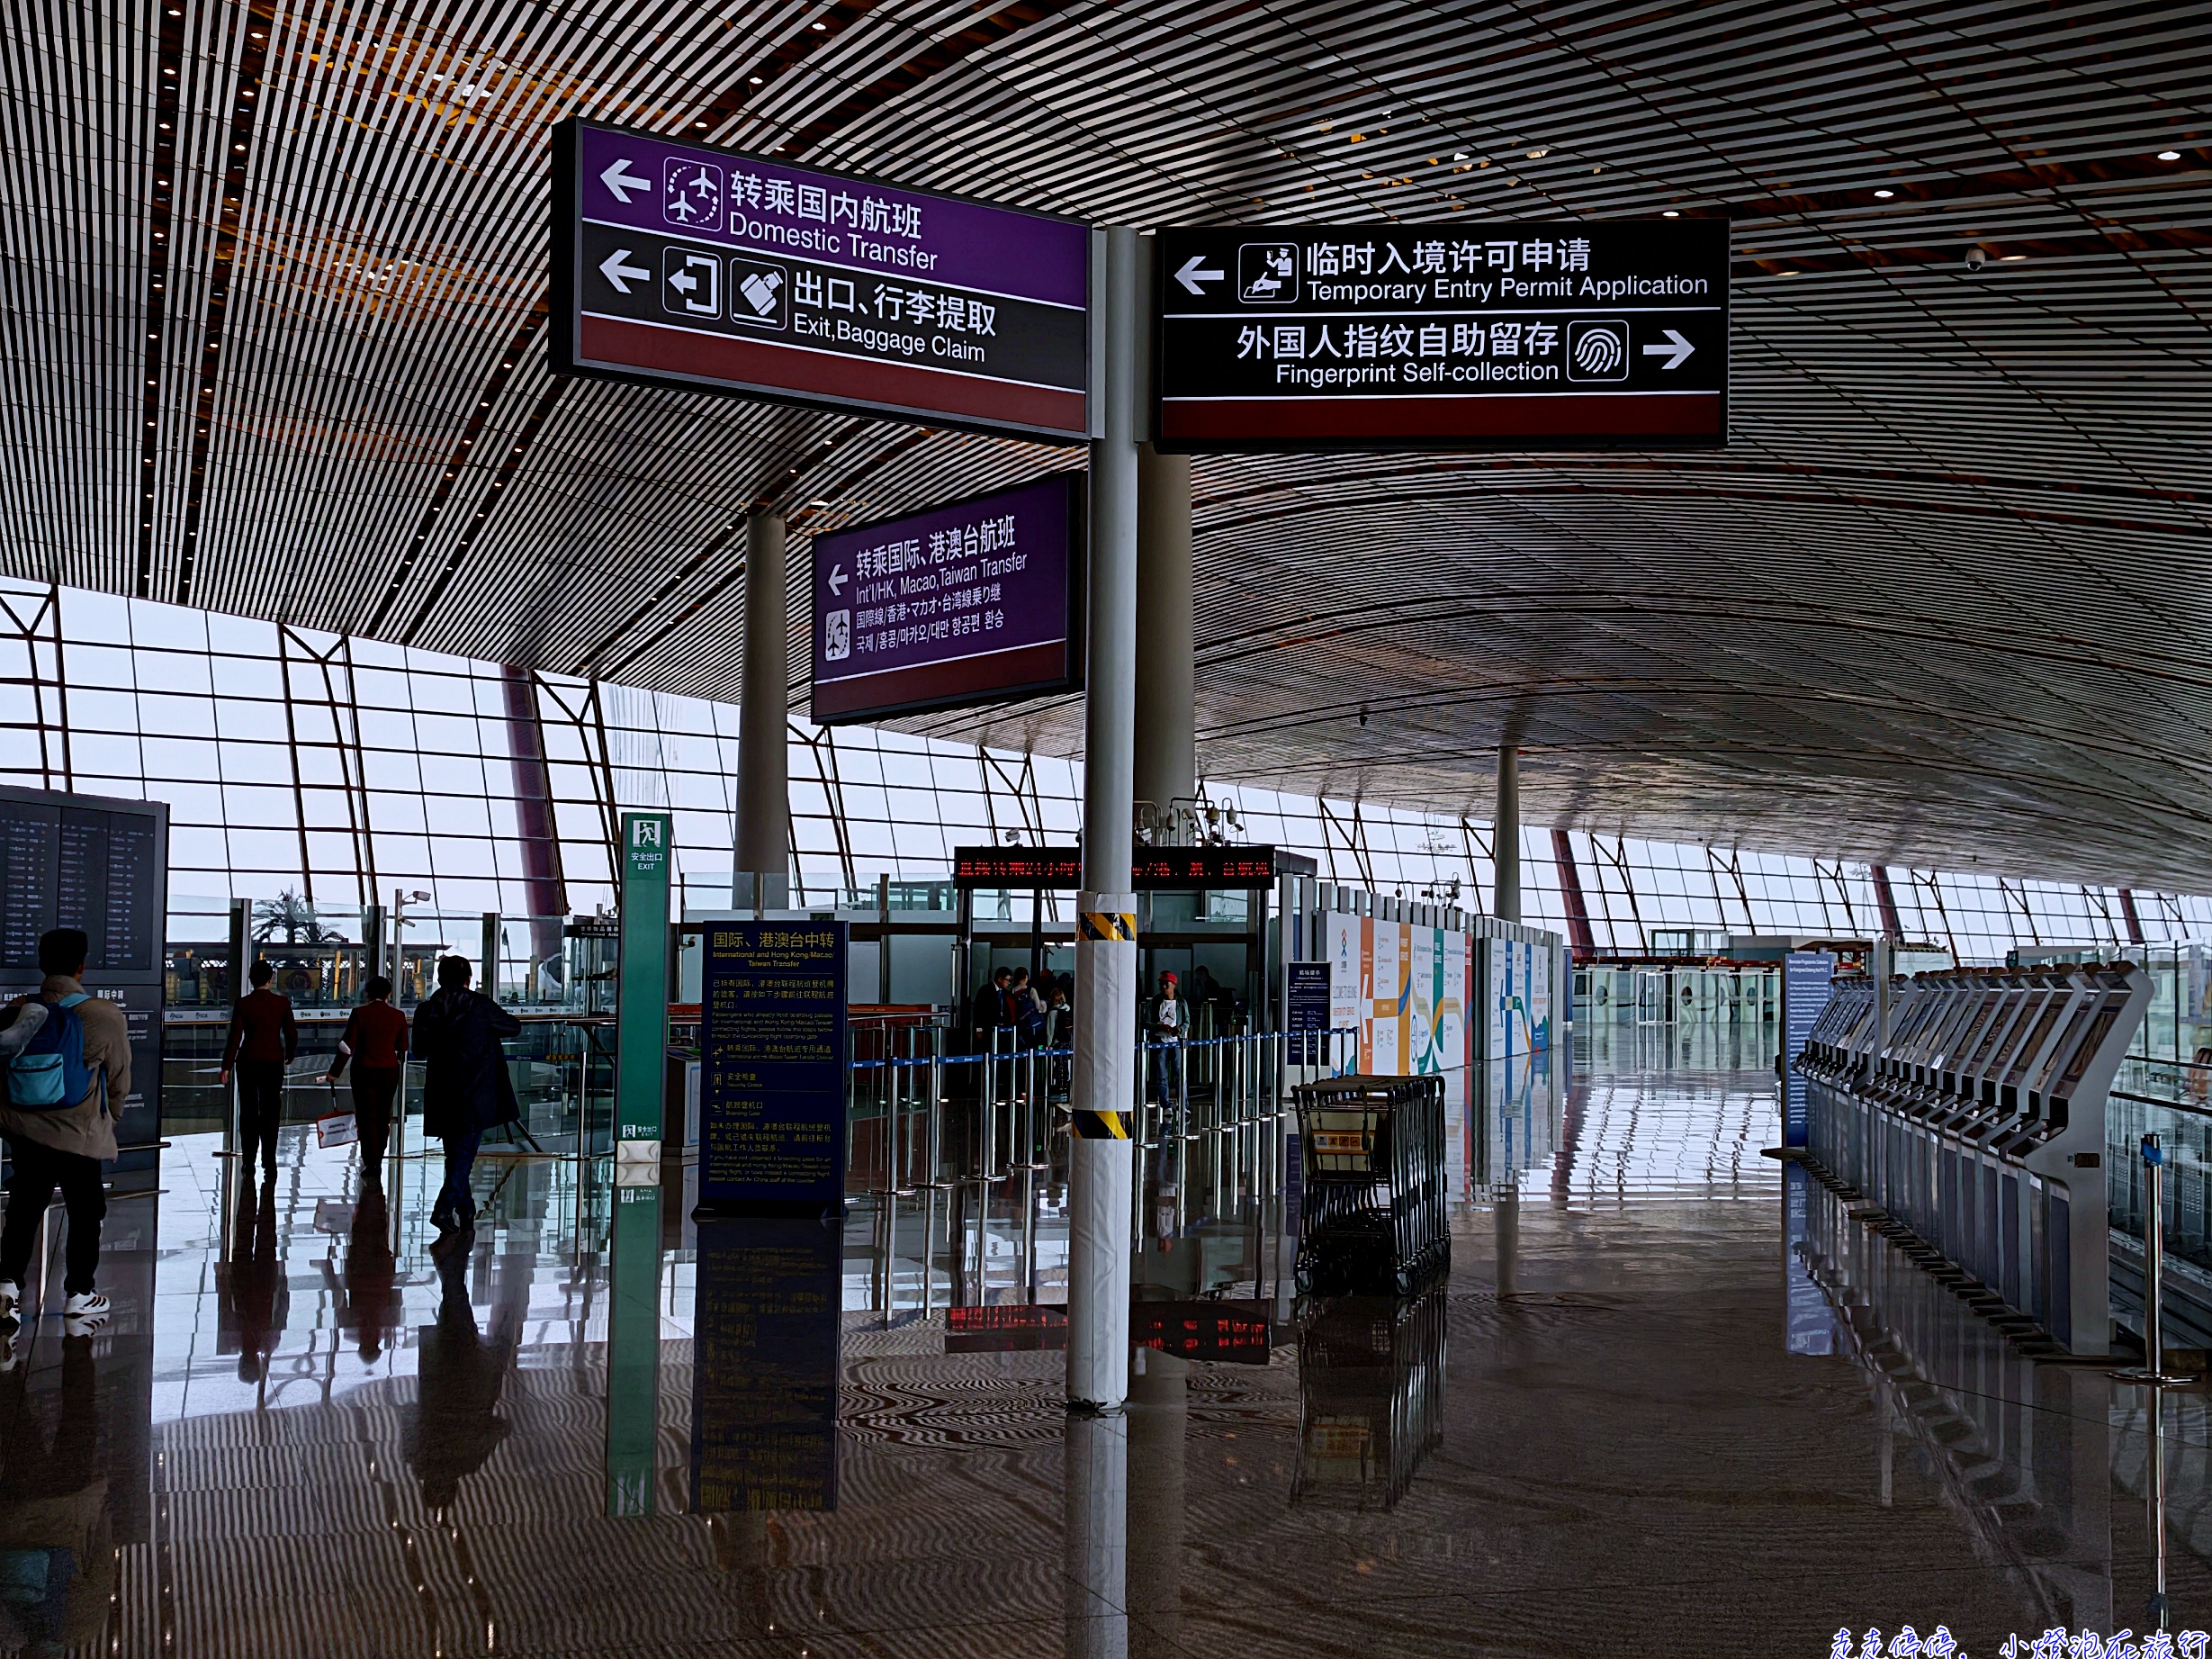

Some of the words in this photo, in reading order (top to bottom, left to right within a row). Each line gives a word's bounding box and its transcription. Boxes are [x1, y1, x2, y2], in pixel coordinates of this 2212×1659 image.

[730, 170, 922, 239] 转乘国内航班
[730, 212, 841, 255] Domestic
[848, 233, 938, 271] Transfer
[1307, 238, 1591, 275] 临时入境许可申请
[1308, 280, 1426, 303] Temporary
[1434, 279, 1492, 302] Entry
[1501, 275, 1573, 299] Permit
[1580, 275, 1708, 300] Application
[795, 271, 996, 337] 出口、行李提取
[931, 336, 985, 363] Claim
[1237, 321, 1559, 360] 外国人指纹自助留存
[1276, 363, 1397, 388] Fingerprint
[1403, 361, 1559, 383] Self-collection
[856, 514, 1015, 582] 转乘国际、港澳台航班
[980, 552, 1027, 578] Transfer
[952, 612, 980, 636] 항공편
[985, 609, 1004, 628] 환승
[631, 852, 662, 861] 安全出口
[713, 932, 834, 948] 国际、港澳台中转
